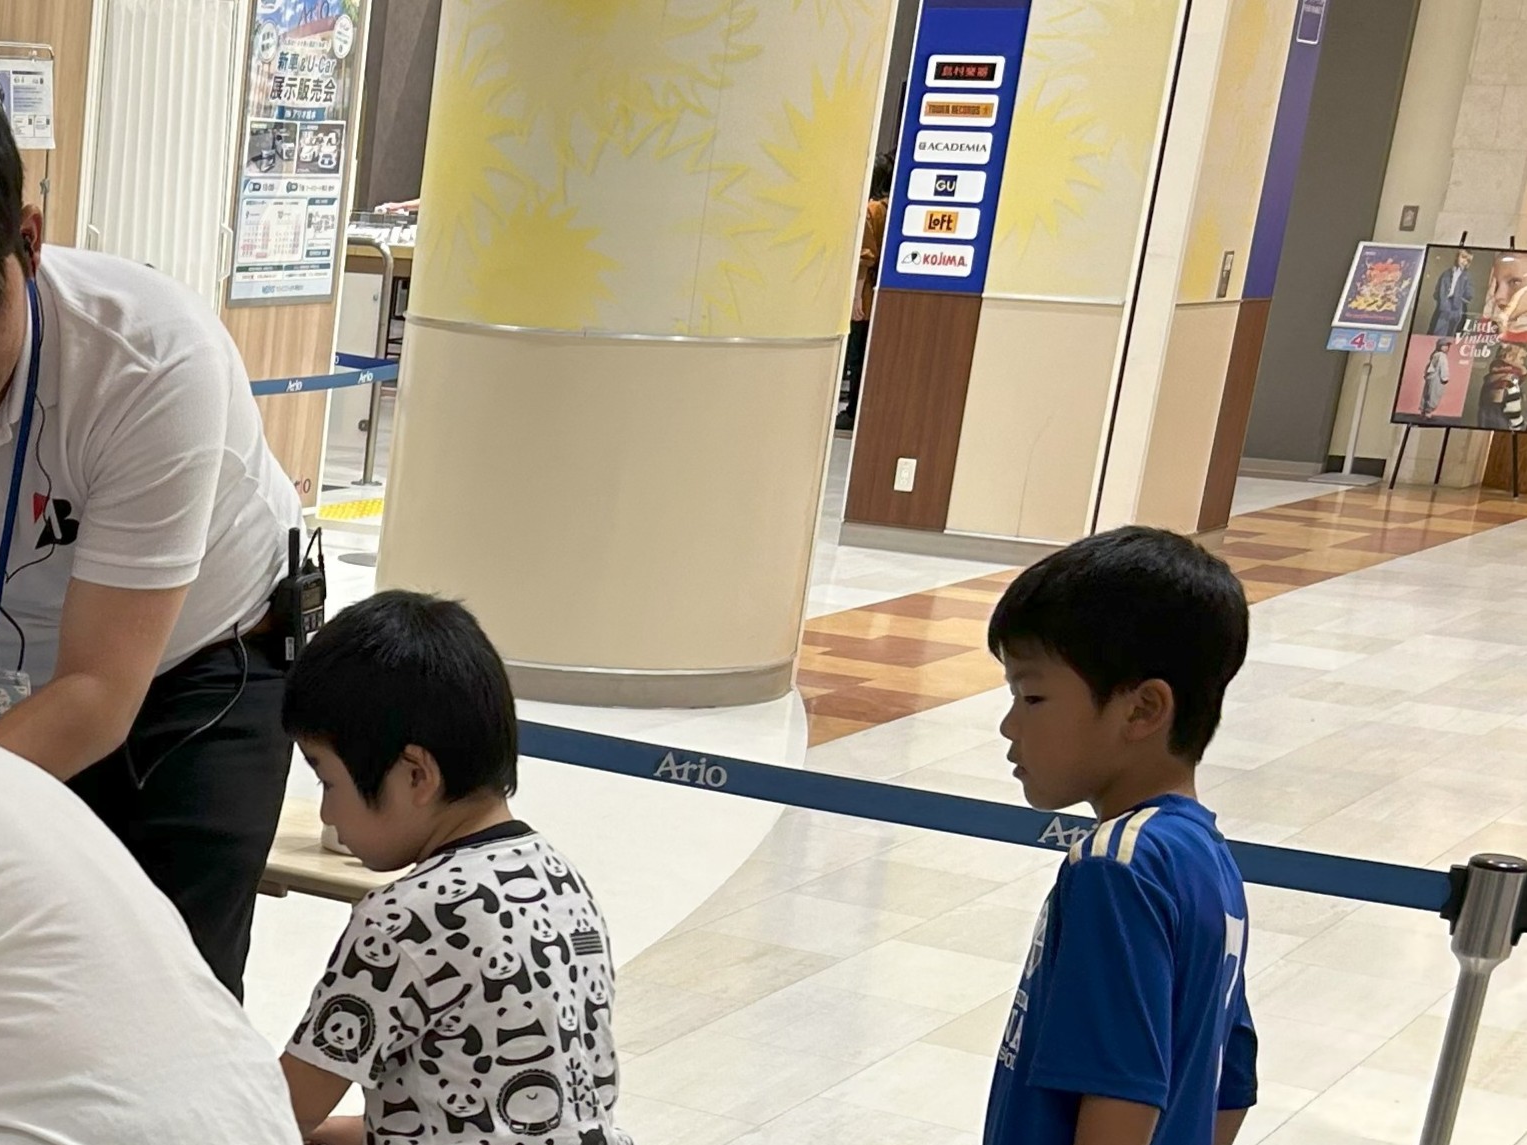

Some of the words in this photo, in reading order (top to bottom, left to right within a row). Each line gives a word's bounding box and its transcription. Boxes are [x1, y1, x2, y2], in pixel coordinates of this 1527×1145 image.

[270, 76, 335, 102] 展示販売会
[927, 142, 987, 153] ACADEMIA
[935, 179, 956, 191] GU
[1463, 318, 1499, 334] Little
[1455, 332, 1501, 346] Vintage
[1459, 345, 1492, 359] Club
[653, 751, 728, 788] Ario
[1037, 816, 1098, 848] Ar
